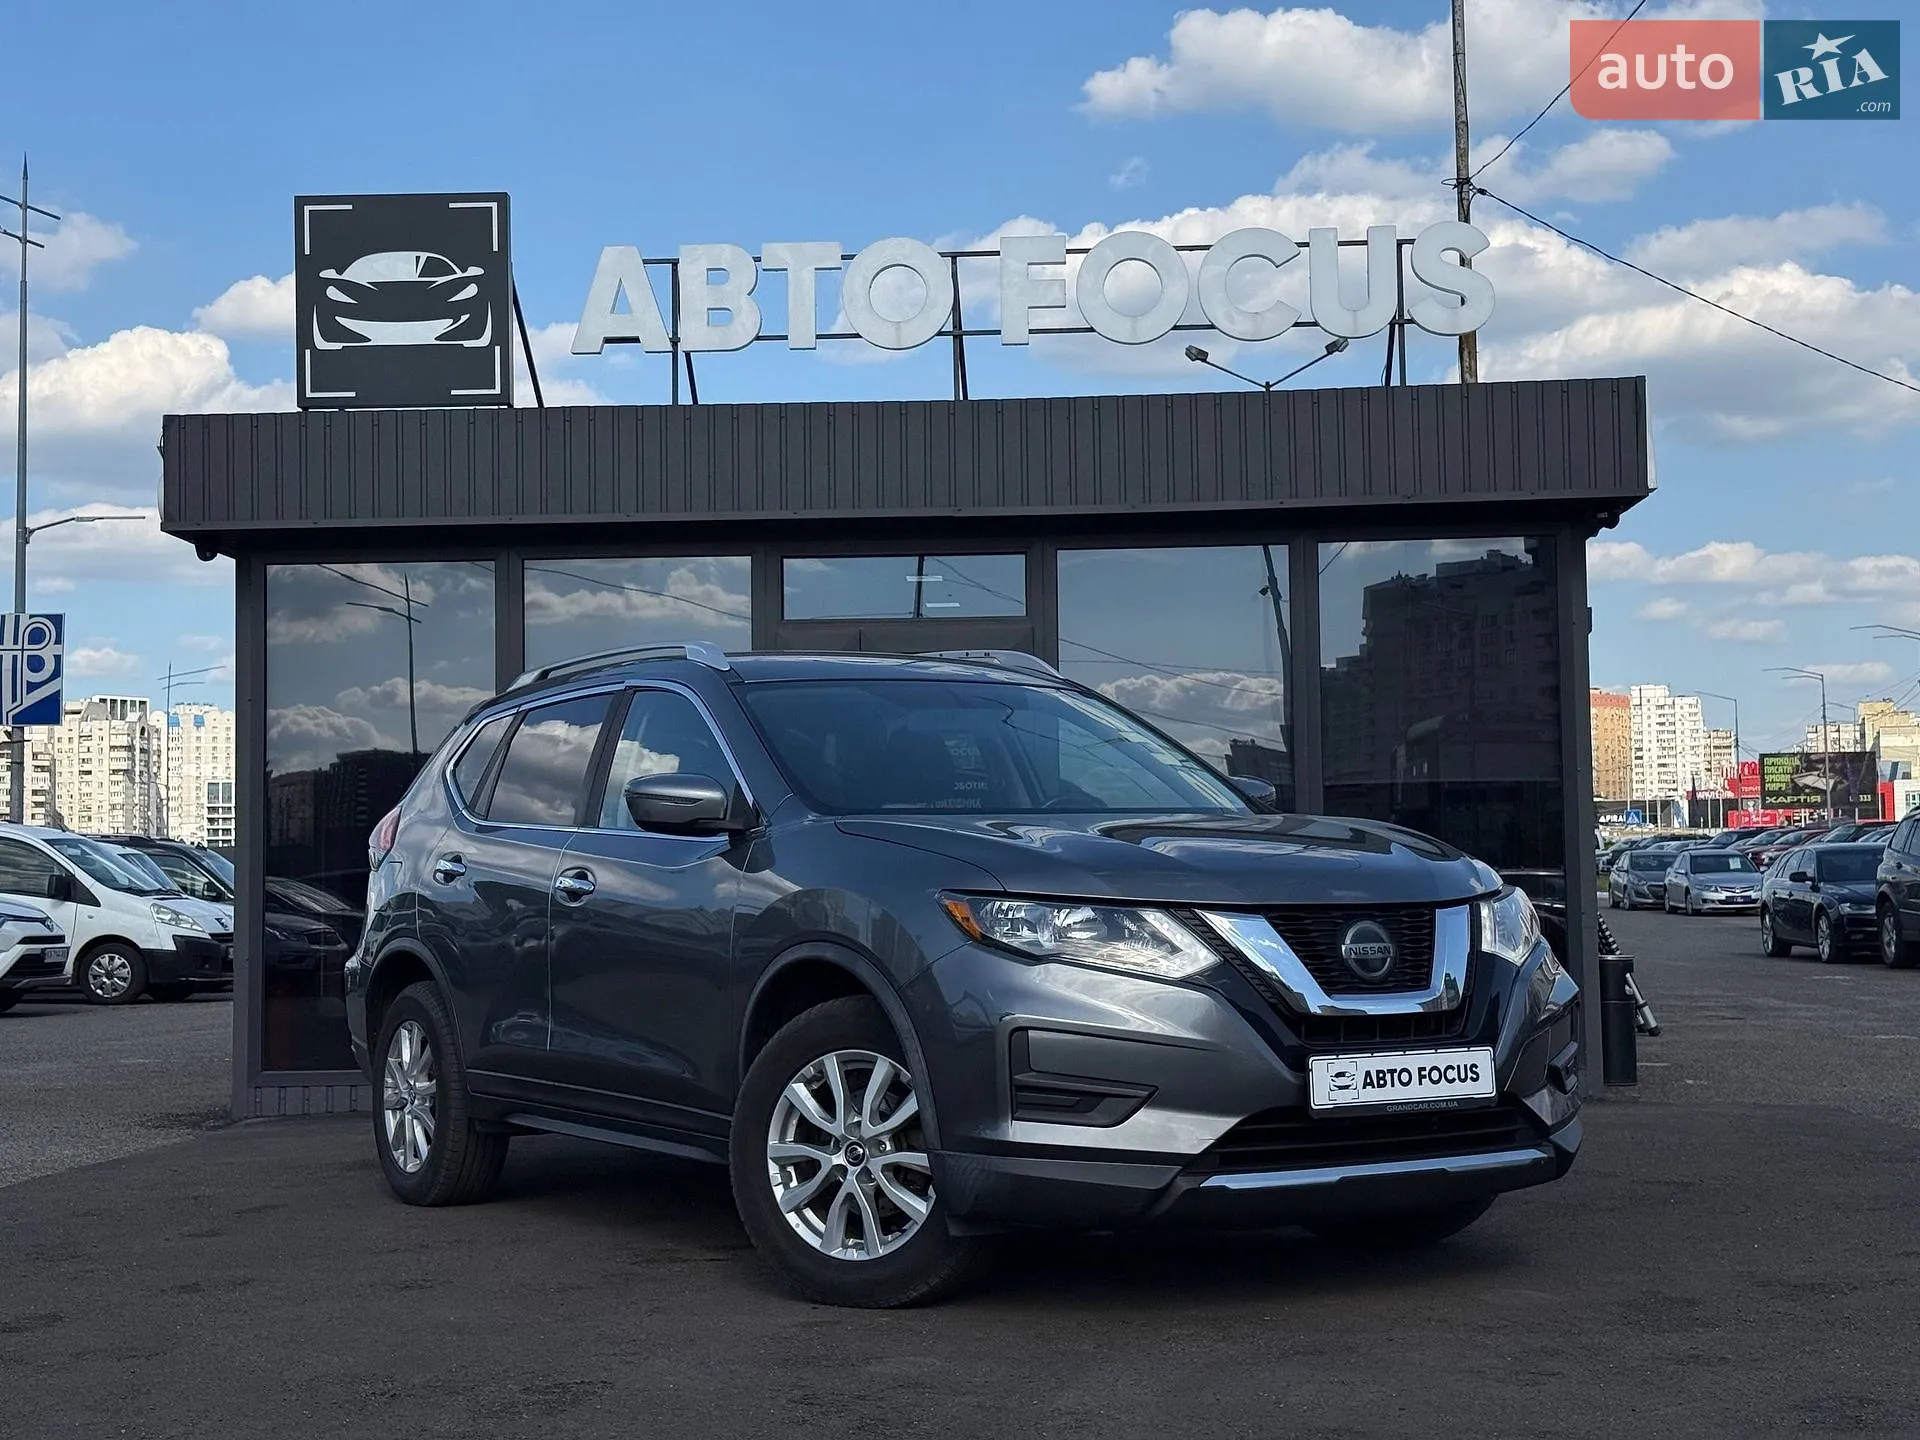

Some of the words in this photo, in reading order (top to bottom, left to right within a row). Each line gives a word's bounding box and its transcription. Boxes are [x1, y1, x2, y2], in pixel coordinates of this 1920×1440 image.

[571, 237, 954, 355] АВТО
[1000, 221, 1495, 346] FOCUS
[1765, 795, 1822, 804] ХАРТІЯ
[1349, 946, 1391, 956] NISSAN
[1362, 1067, 1413, 1090] АВТО
[1418, 1063, 1480, 1086] FOCUS
